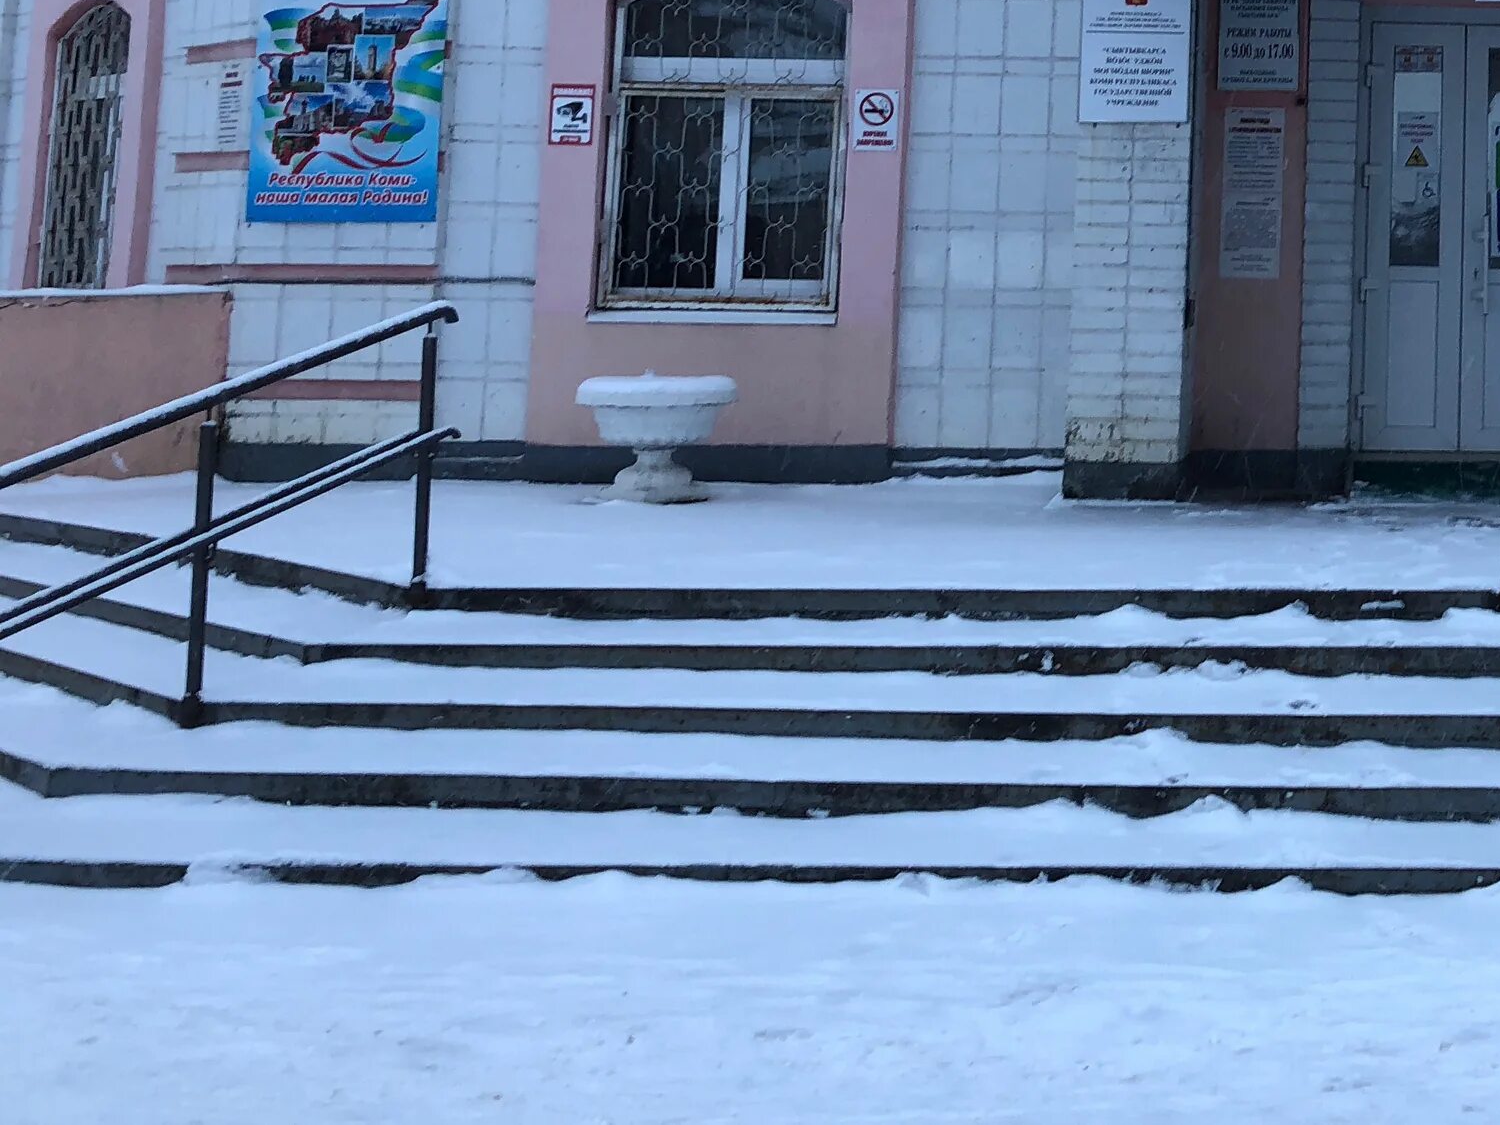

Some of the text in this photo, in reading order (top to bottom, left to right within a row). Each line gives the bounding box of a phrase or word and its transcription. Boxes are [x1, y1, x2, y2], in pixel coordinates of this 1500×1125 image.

[1226, 27, 1292, 38] РЕЖИМ РАБОТЫ
[1231, 43, 1252, 59] 9.00
[1253, 48, 1266, 60] до
[1268, 43, 1294, 59] 17.00
[268, 172, 416, 188] Республика Коми-
[255, 190, 429, 205] наша малая Родина!
